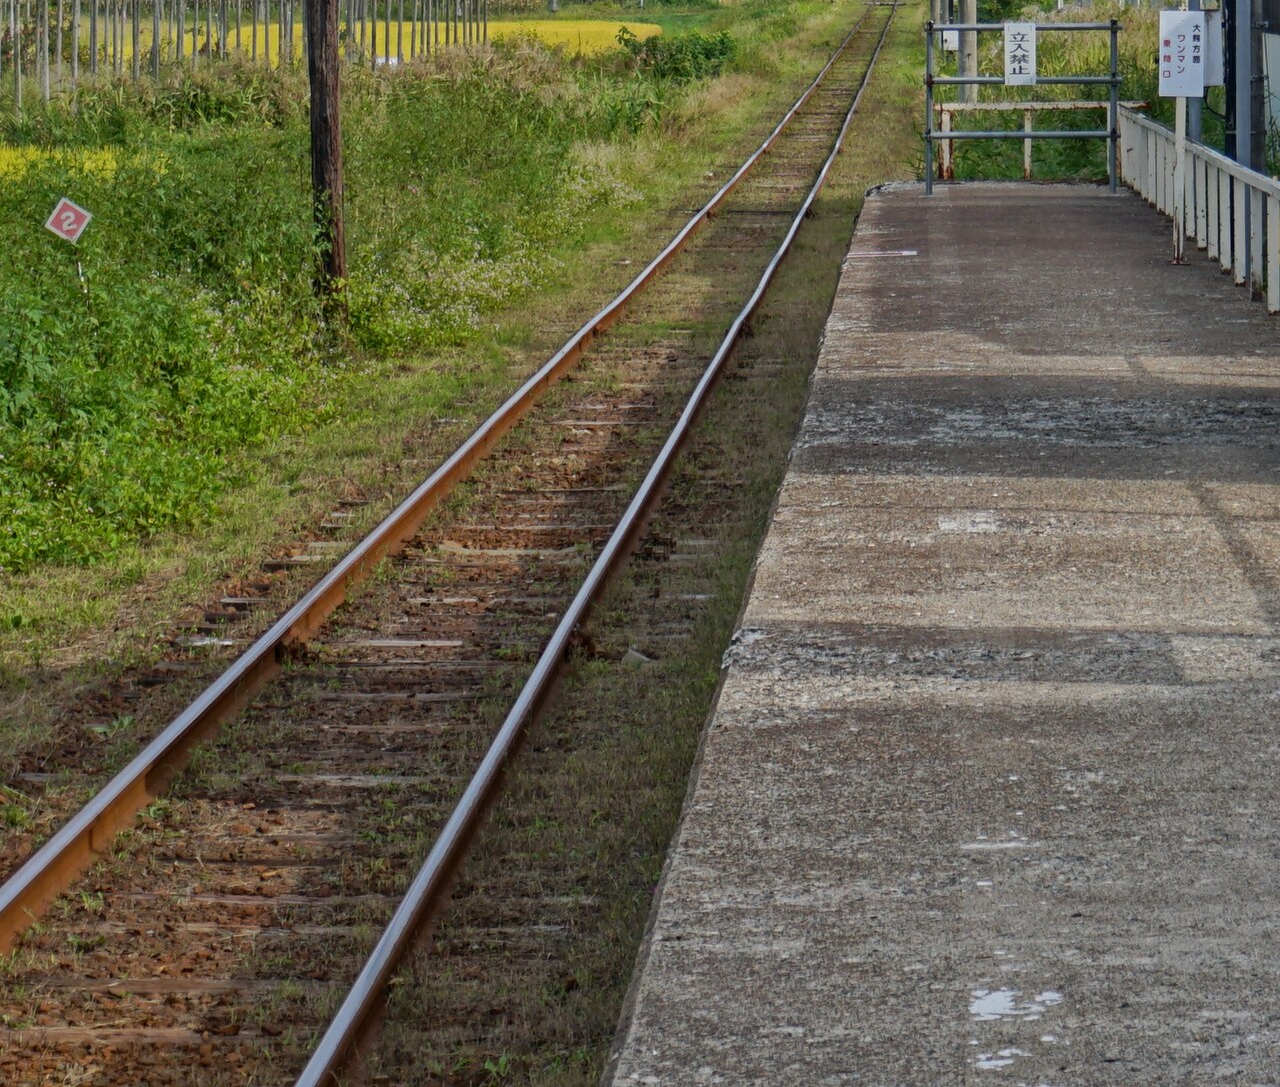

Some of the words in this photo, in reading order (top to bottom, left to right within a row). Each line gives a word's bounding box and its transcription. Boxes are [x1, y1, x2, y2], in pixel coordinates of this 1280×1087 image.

[1009, 32, 1030, 75] 立入禁止
[1177, 34, 1185, 74] ワンマン
[60, 211, 77, 231] 2
